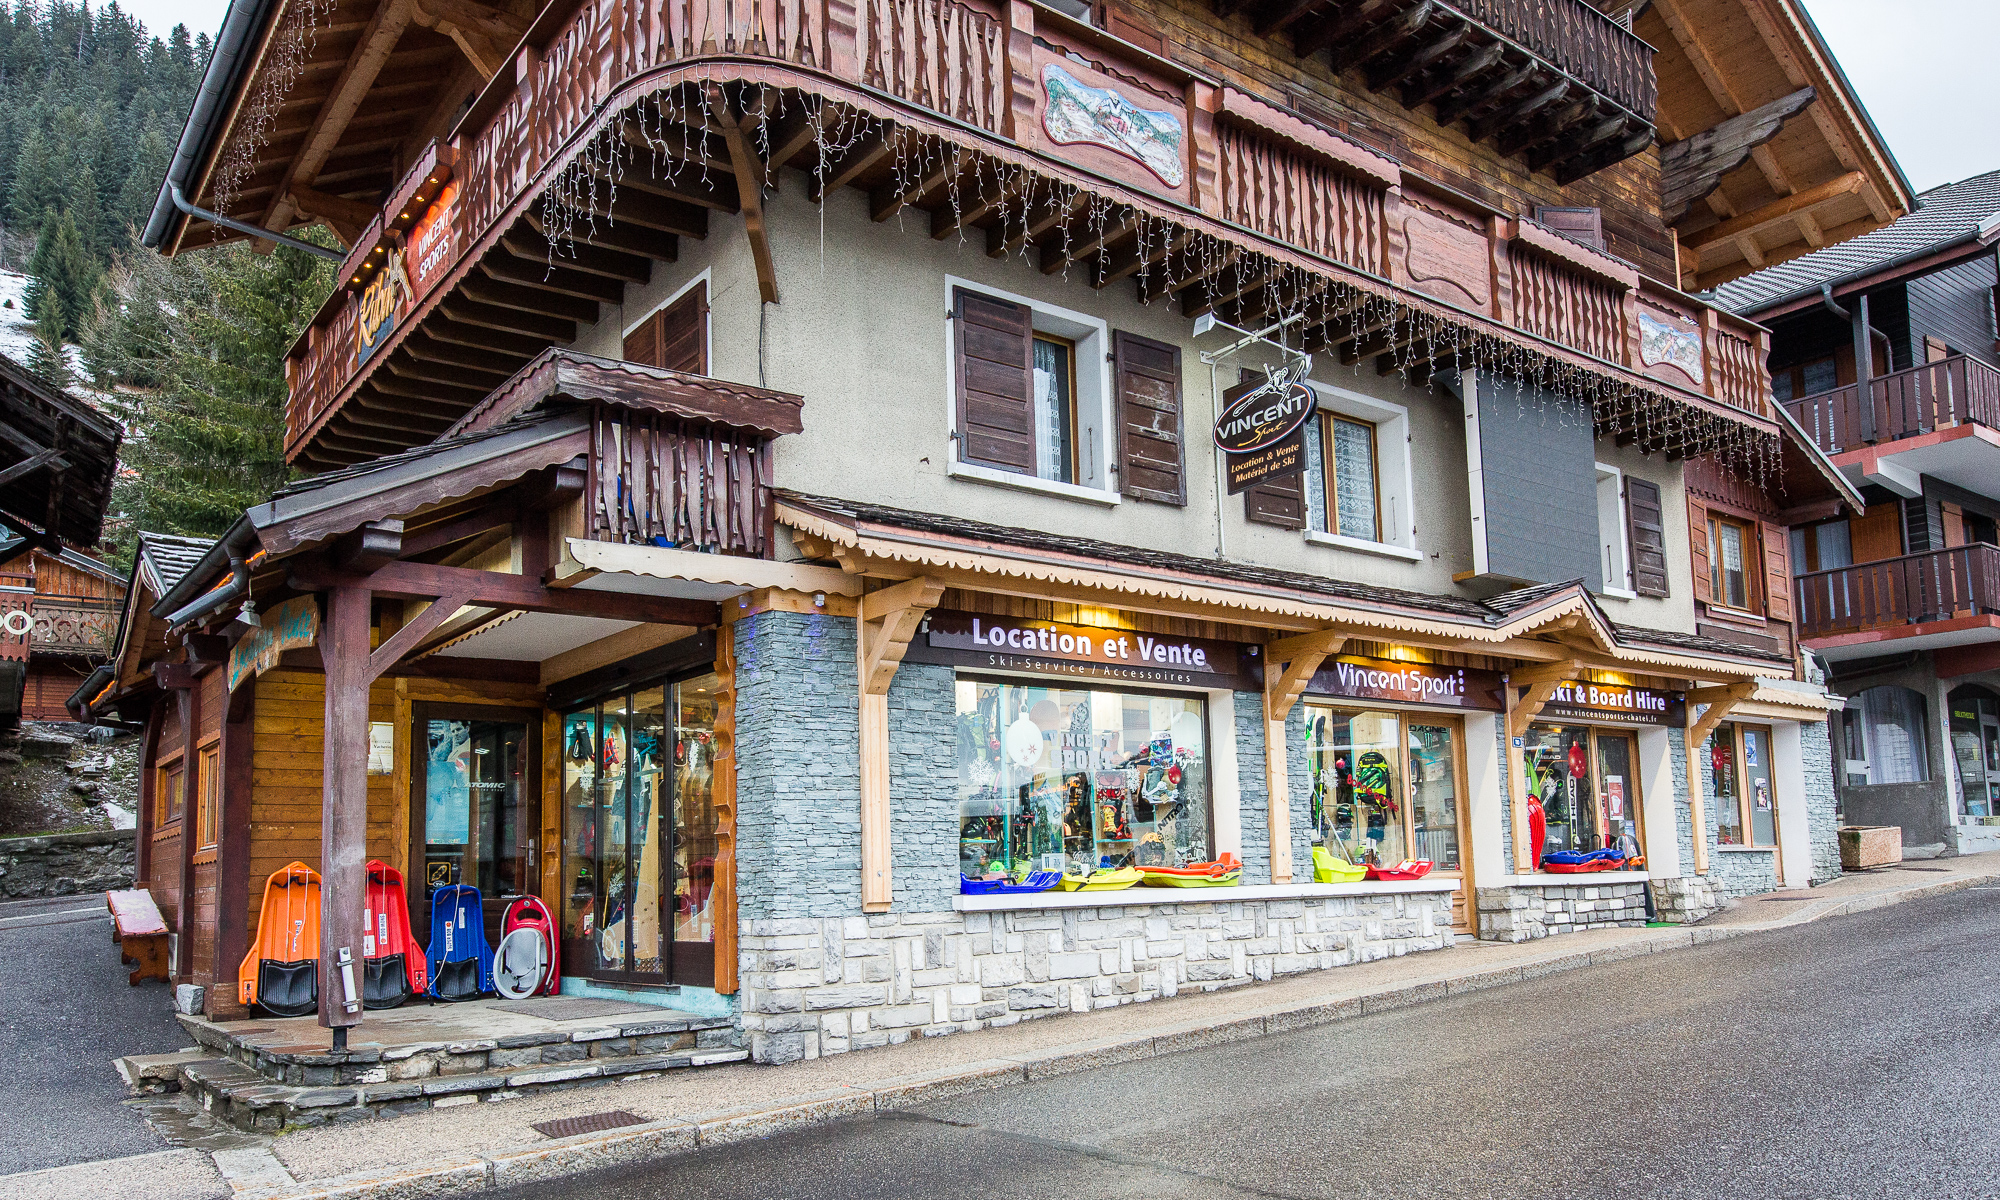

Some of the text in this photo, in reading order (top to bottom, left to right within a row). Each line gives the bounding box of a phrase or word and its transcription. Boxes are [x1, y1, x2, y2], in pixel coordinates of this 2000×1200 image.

[418, 206, 450, 257] VINCENT
[418, 235, 449, 281] SPORTS
[1216, 393, 1306, 440] VINCENT
[1231, 443, 1300, 474] Location & Vente
[1235, 454, 1296, 484] Matériel de Ski
[972, 618, 1206, 667] Location et Vente
[989, 654, 1085, 674] Ski-Service
[1103, 665, 1191, 683] Accessoires
[1336, 662, 1457, 700] Vincent Sport
[1575, 684, 1587, 704] &
[1589, 686, 1633, 708] Board
[1636, 691, 1666, 712] Hire
[1555, 708, 1657, 723] www.vincentsports-chatel.fr
[1049, 732, 1114, 748] VINCENT
[1050, 749, 1114, 770] SPORT
[464, 781, 506, 789] ATOMIC
[1569, 778, 1577, 817] HEAD
[1158, 803, 1183, 831] NITRO
